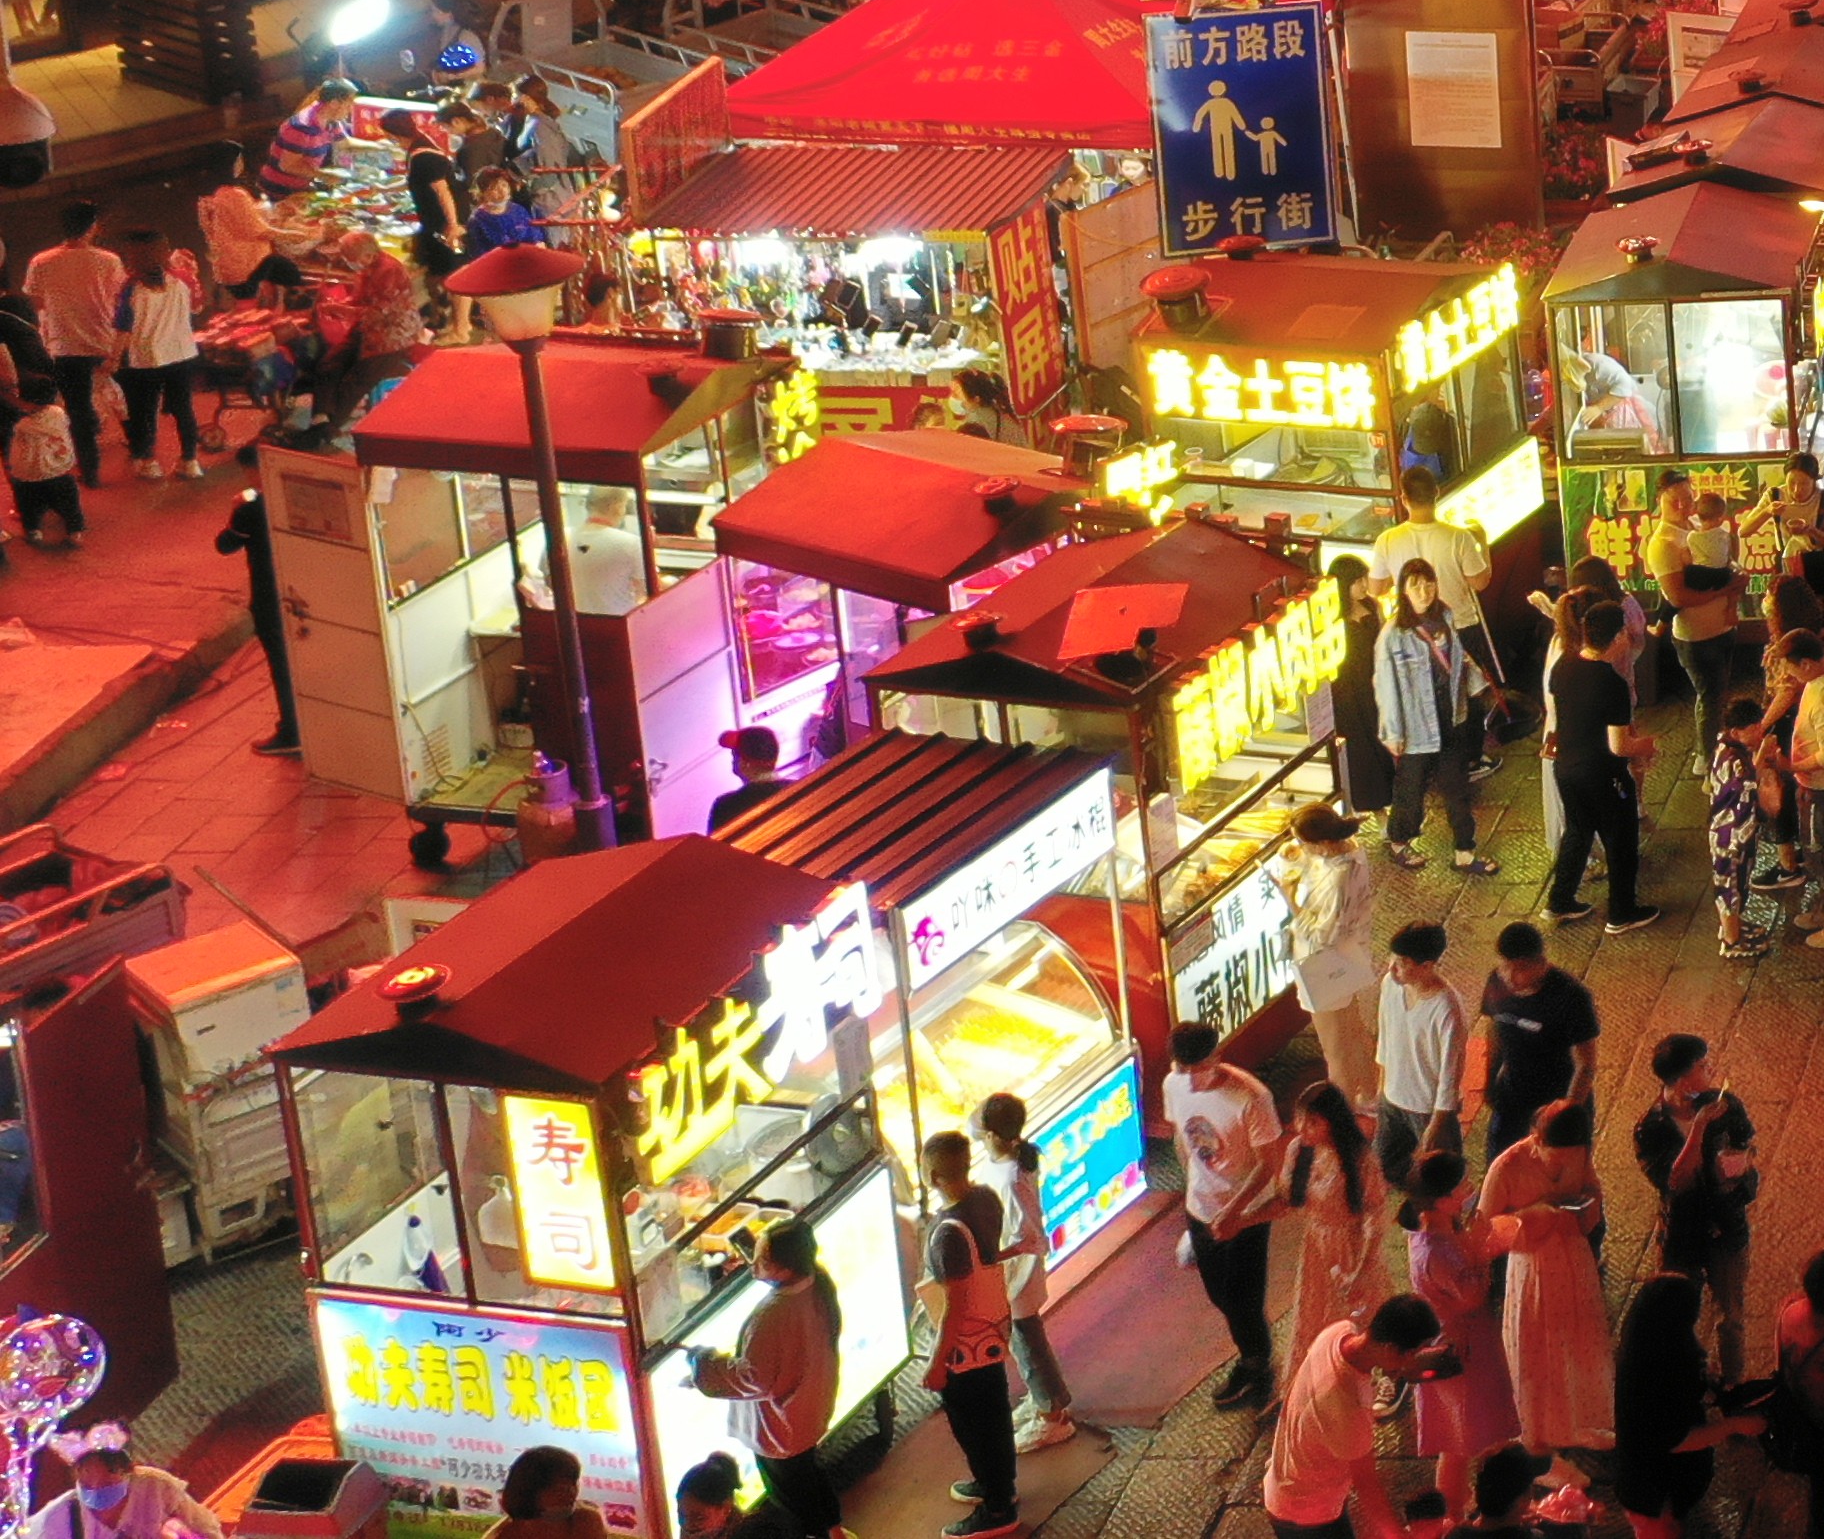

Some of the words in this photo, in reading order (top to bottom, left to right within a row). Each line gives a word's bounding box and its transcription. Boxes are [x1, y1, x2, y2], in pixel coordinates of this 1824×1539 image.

[1160, 19, 1307, 70] 前方路段
[1181, 191, 1315, 242] 步行街
[997, 216, 1051, 405] 贴屏
[1147, 348, 1377, 430] 黄金土豆饼
[530, 1115, 599, 1273] 寿司
[343, 1332, 497, 1421] 功夫寿司
[503, 1349, 622, 1436] 米饭团
